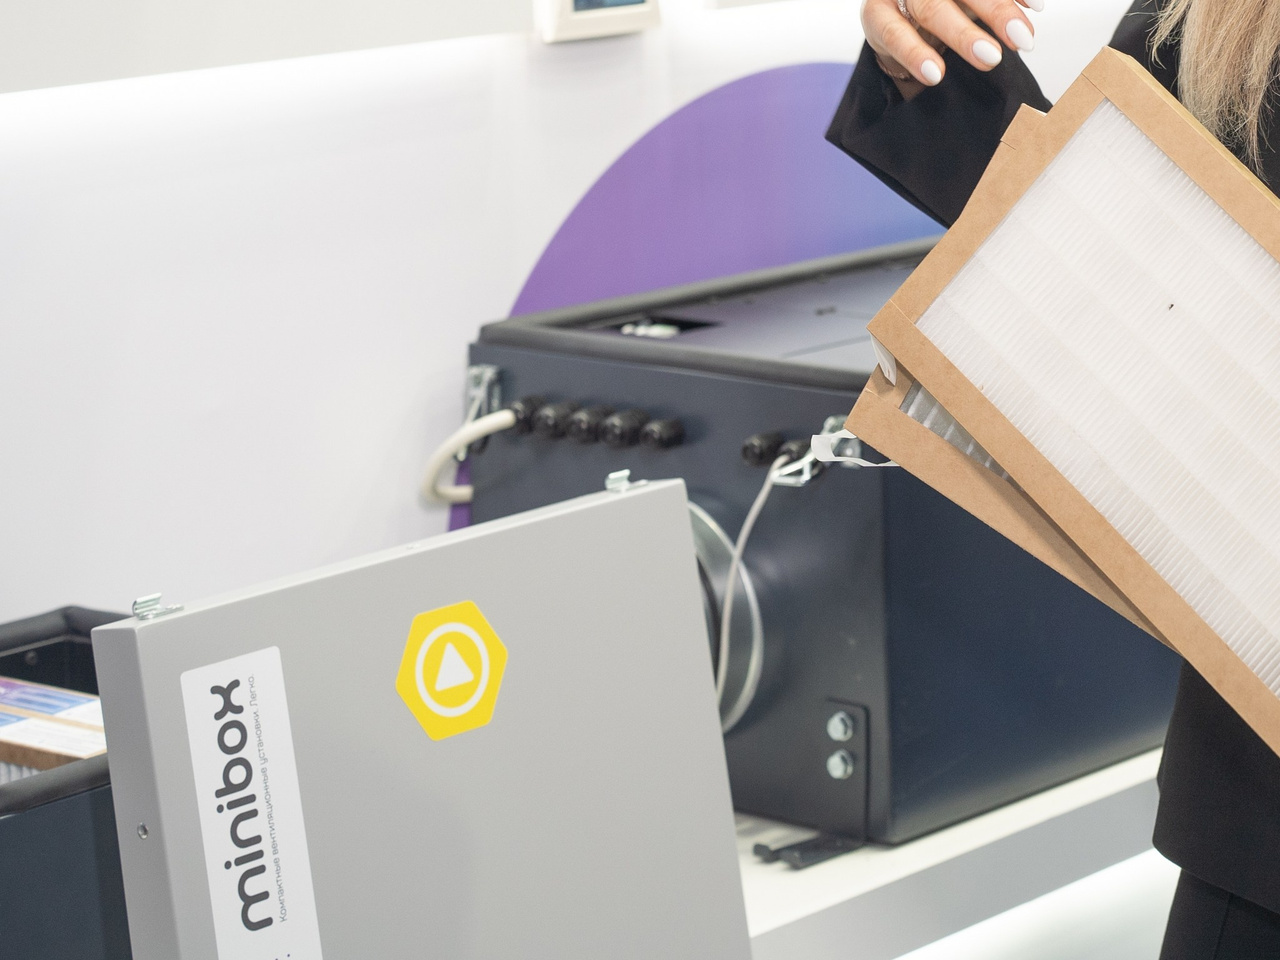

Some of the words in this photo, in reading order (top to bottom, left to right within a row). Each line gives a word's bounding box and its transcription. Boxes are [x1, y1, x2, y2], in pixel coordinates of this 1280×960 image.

[210, 678, 274, 931] minibox
[260, 766, 279, 855] вентиляционные
[274, 856, 288, 923] Компактные
